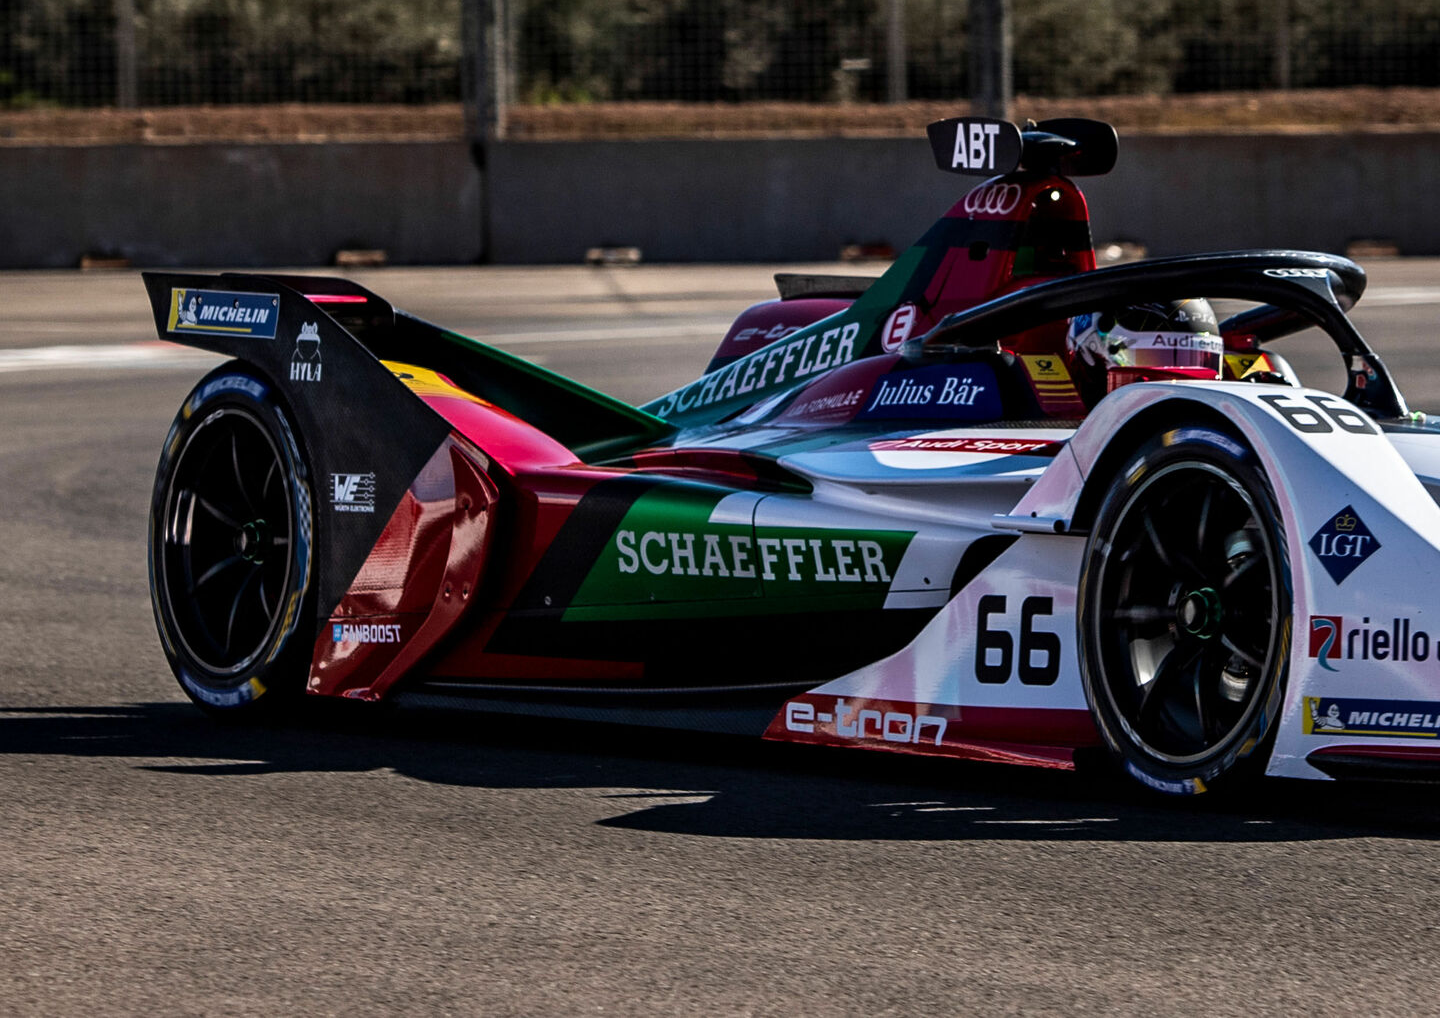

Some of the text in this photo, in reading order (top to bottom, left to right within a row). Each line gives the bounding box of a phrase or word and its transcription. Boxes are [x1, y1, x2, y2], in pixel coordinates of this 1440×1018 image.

[952, 122, 999, 169] ABT
[199, 305, 270, 324] MICHELIN
[1152, 334, 1194, 348] Audi
[289, 361, 322, 382] HYLA
[657, 322, 860, 418] SCHAEFFLER
[868, 377, 985, 412] Julius Bär
[1257, 394, 1378, 435] 66
[897, 439, 1049, 452] Audi Sport
[616, 530, 892, 582] SCHAEFFLER
[1319, 533, 1370, 558] LGT
[975, 594, 1062, 686] 66
[1347, 616, 1430, 662] riello
[785, 698, 948, 746] e-tron
